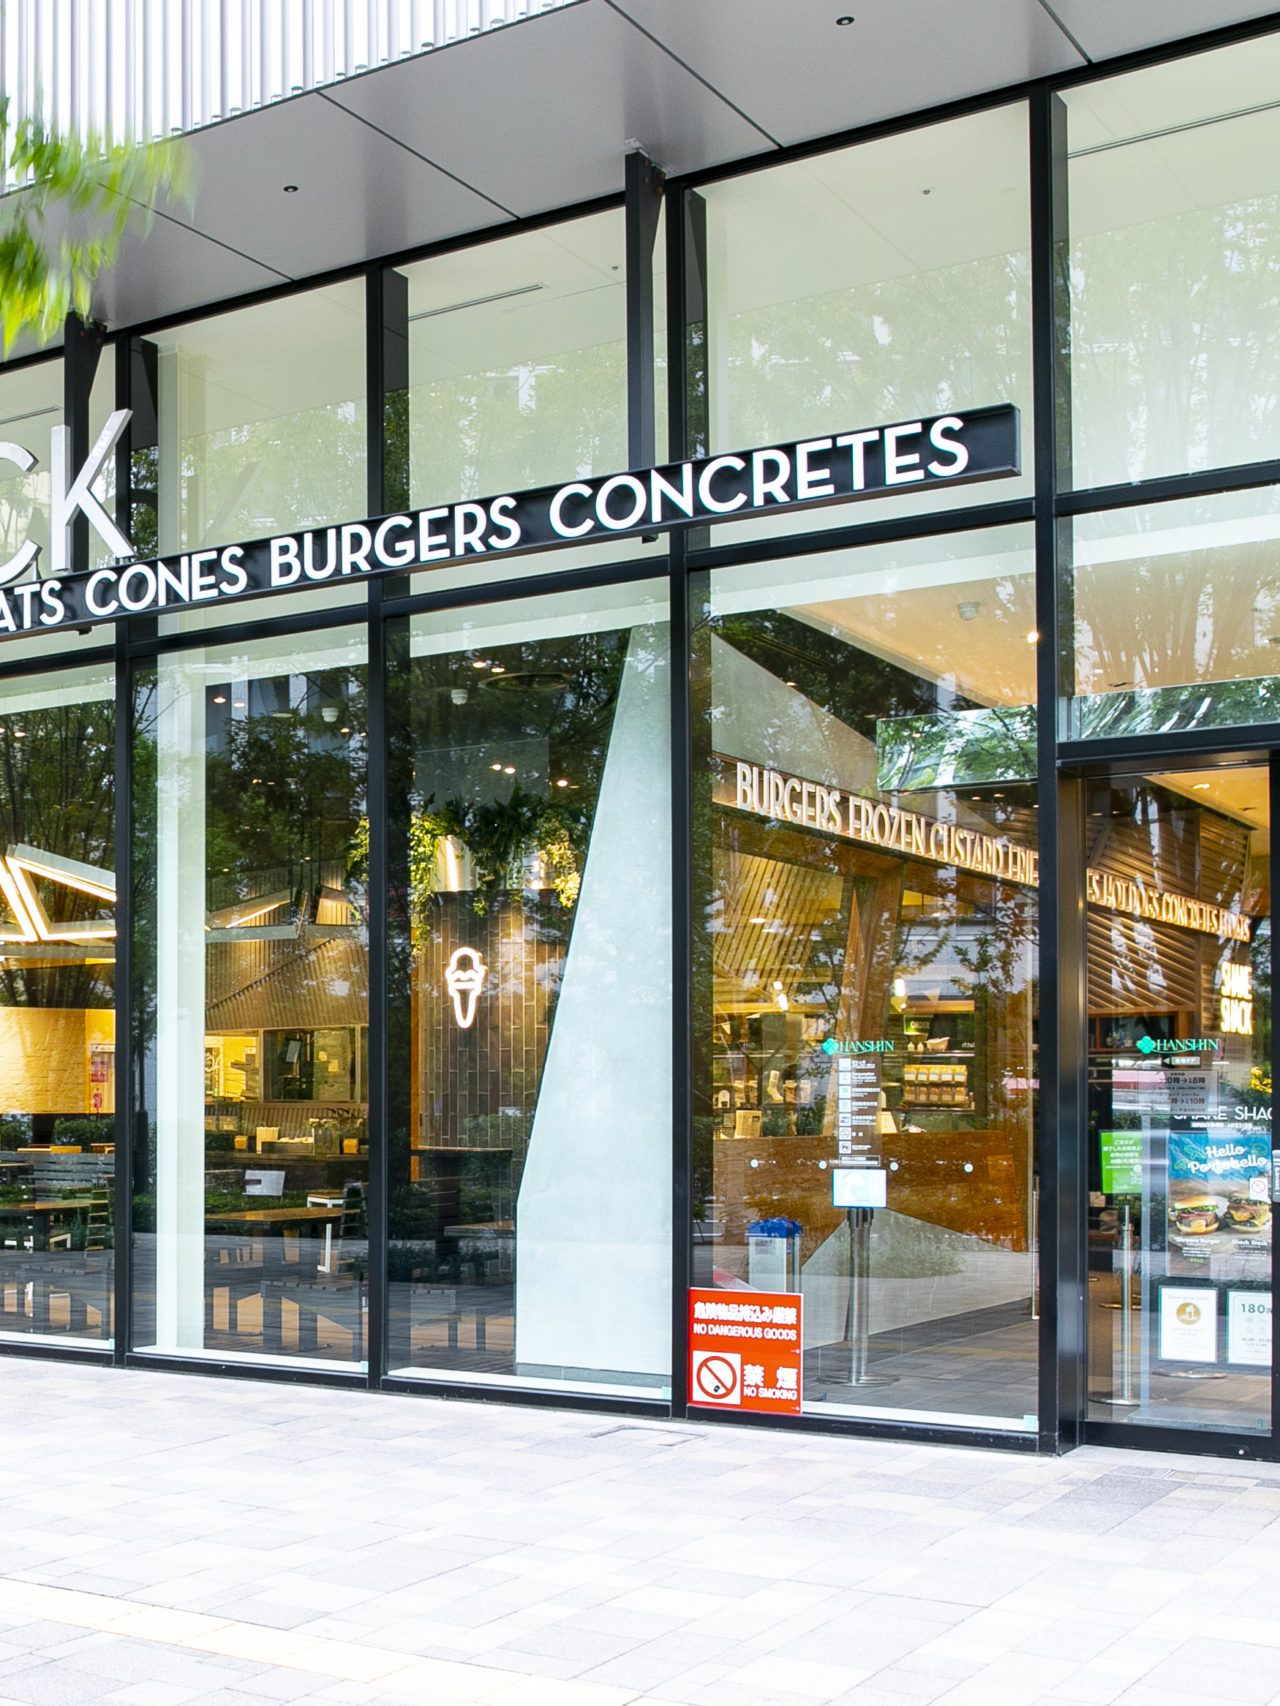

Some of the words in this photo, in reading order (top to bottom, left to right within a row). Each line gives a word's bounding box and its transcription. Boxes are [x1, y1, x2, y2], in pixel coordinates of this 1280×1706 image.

[85, 547, 248, 617] CONES
[270, 496, 521, 586] BURGERS
[549, 416, 969, 538] CONCRETES
[736, 761, 841, 835] BURGERS
[848, 795, 926, 856] FROZEN
[930, 822, 1005, 874] CUSTARD
[1008, 843, 1039, 887] FRIE
[838, 1039, 895, 1054] HANSHIN
[1156, 1038, 1220, 1053] HANSHIN
[1234, 1105, 1272, 1121] SHA
[1205, 1143, 1246, 1159] Hello
[693, 1323, 707, 1335] NO
[708, 1324, 763, 1339] DANGEROUS
[763, 1328, 798, 1341] GOODS
[743, 1386, 757, 1397] NO
[758, 1388, 798, 1401] SMOKING
